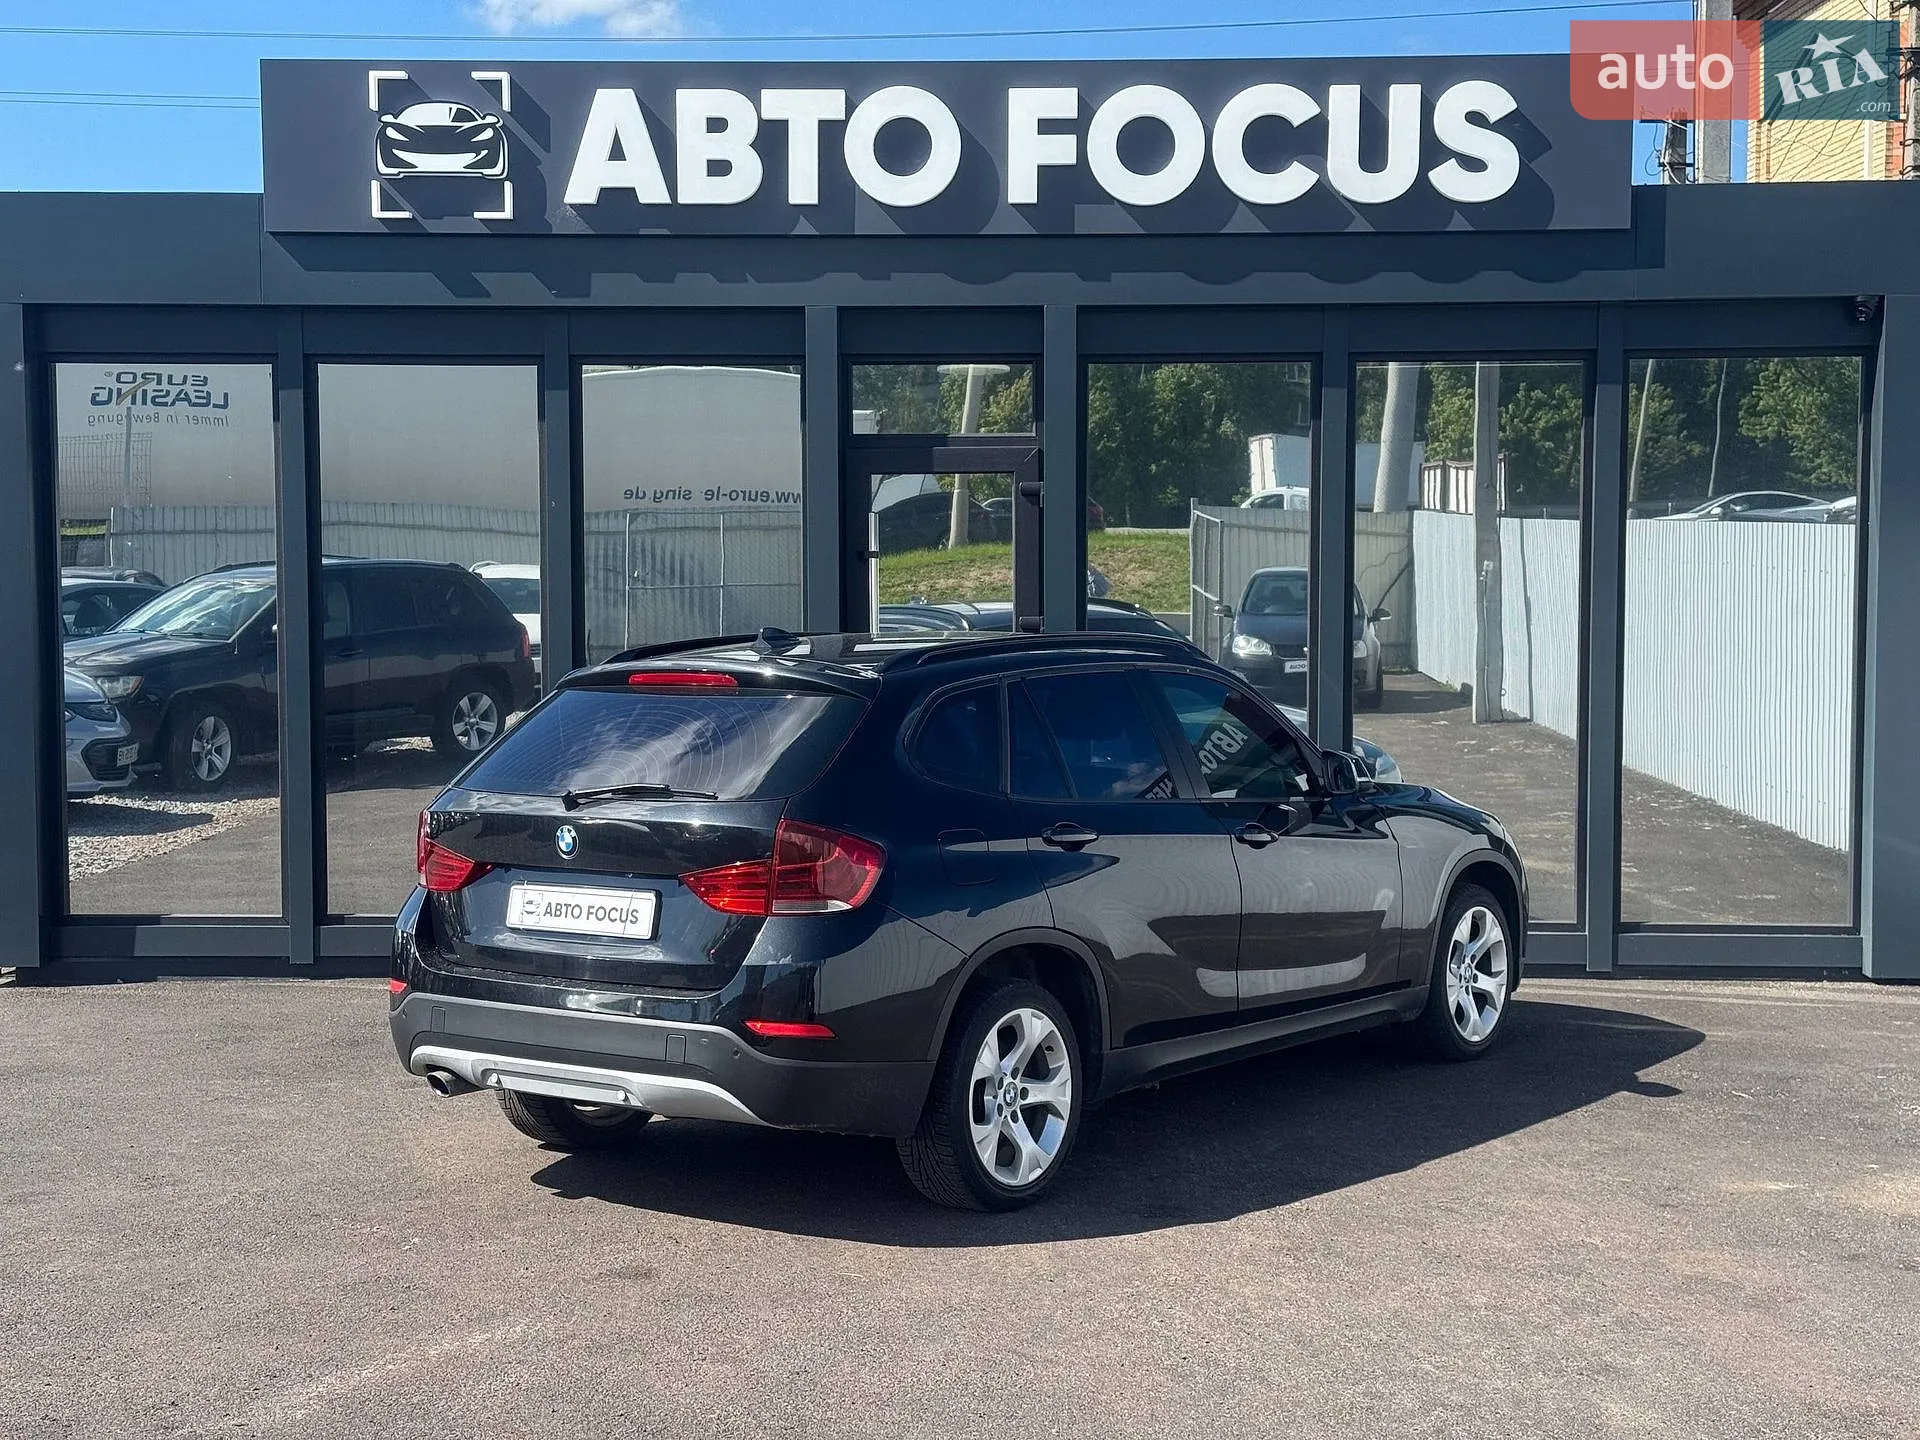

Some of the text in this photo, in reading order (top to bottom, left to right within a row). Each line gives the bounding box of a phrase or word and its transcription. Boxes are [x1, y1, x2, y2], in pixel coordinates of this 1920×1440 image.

[563, 80, 1521, 207] АВТО FOCUS
[586, 905, 640, 925] FOCUS
